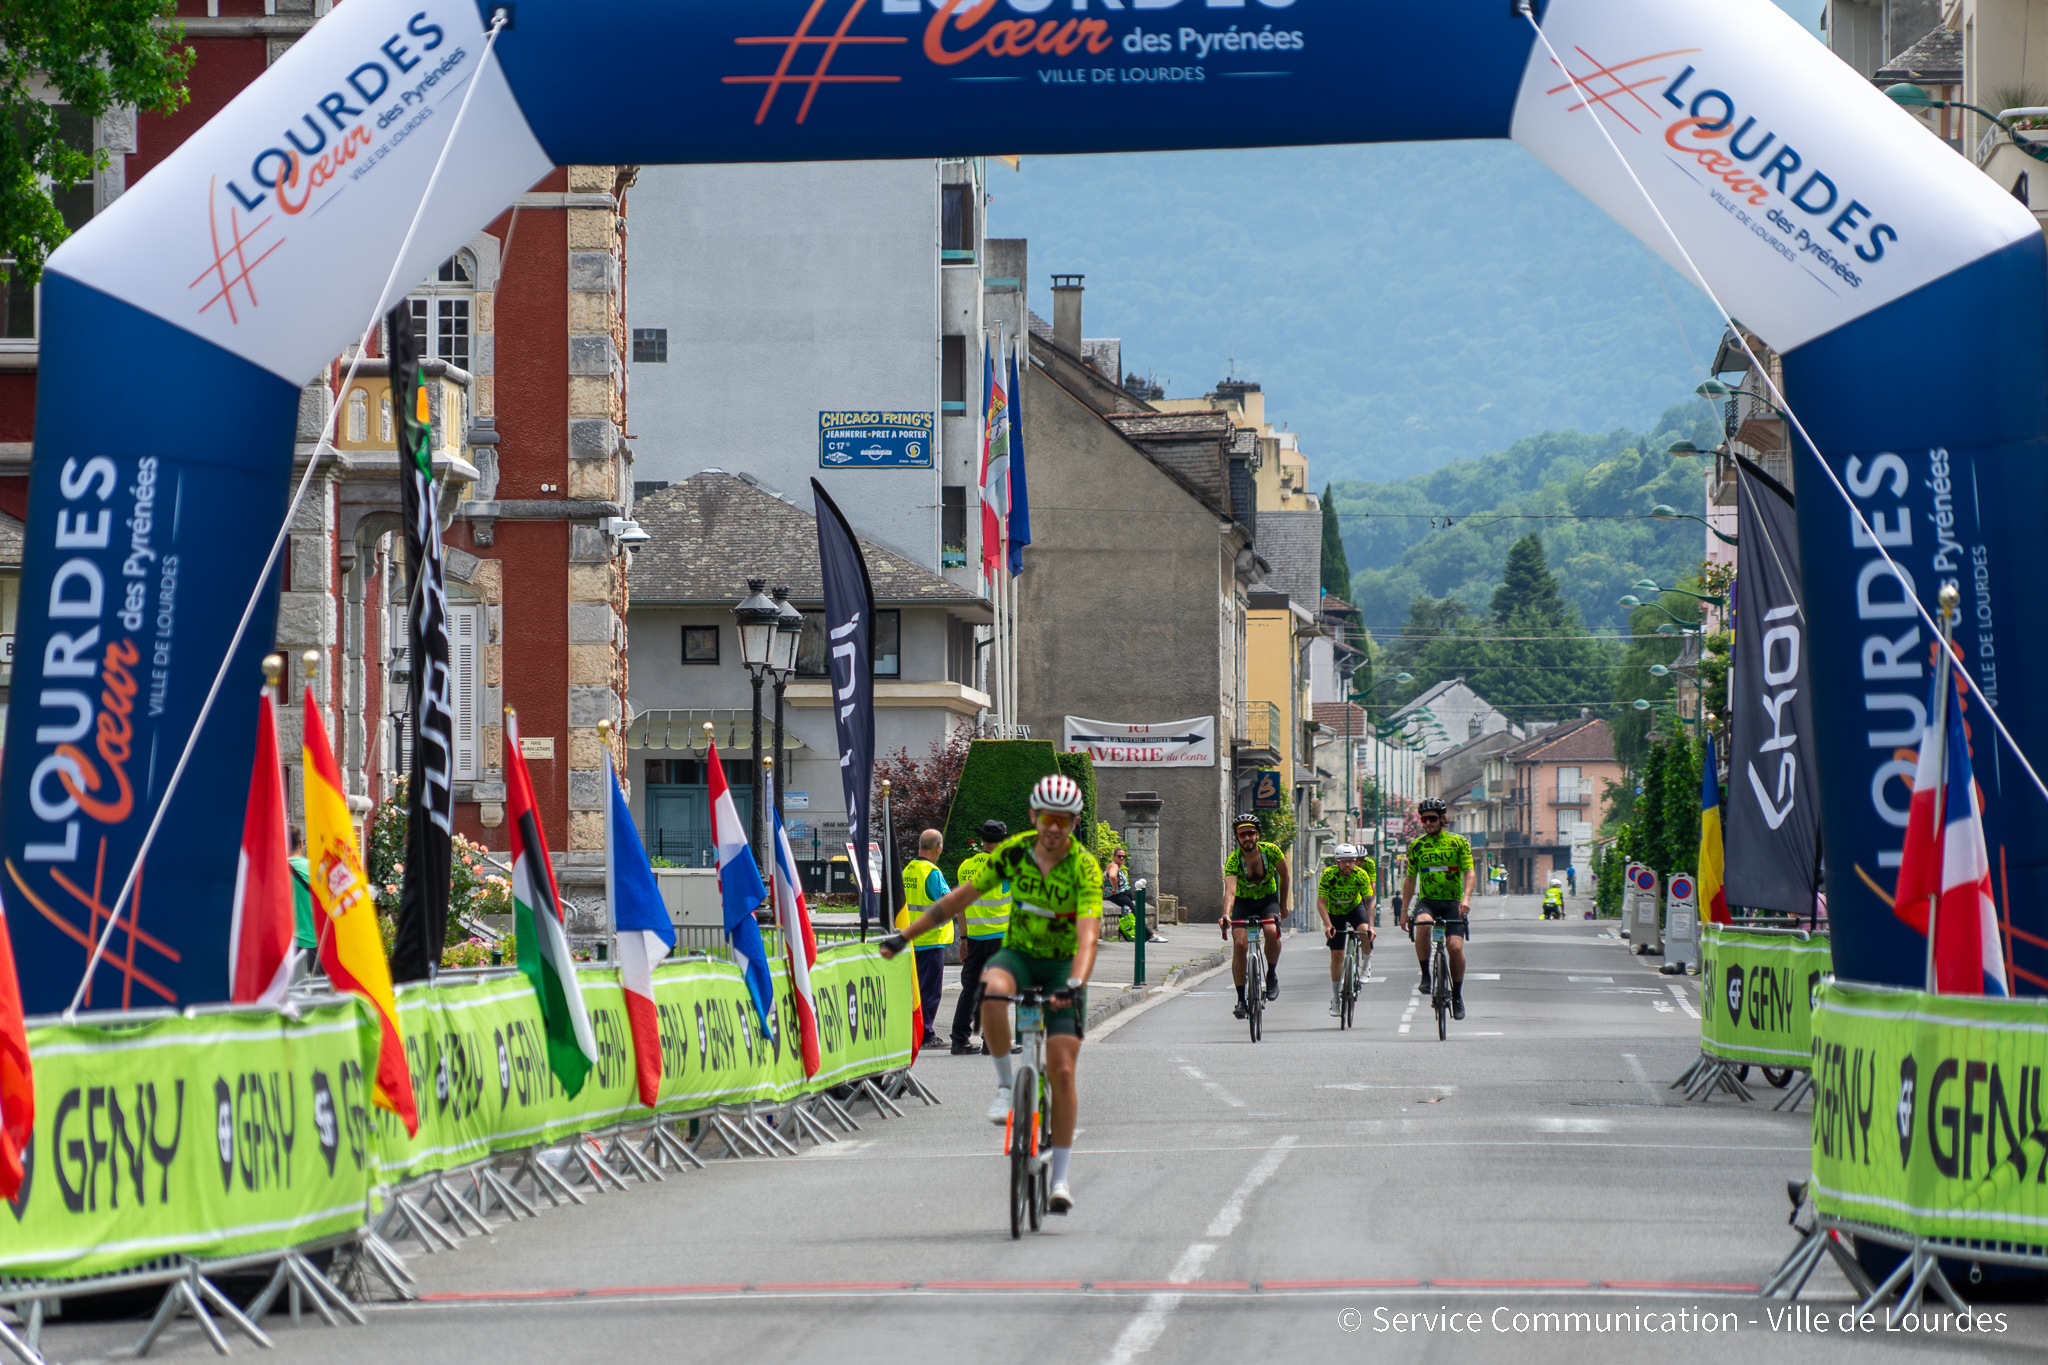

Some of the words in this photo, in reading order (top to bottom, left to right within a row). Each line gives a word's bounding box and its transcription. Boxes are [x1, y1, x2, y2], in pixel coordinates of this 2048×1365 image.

[1038, 68, 1086, 83] VILLE
[1091, 67, 1116, 82] DE
[1120, 66, 1205, 82] LOURDES
[1122, 27, 1172, 53] des
[1178, 24, 1304, 58] Pyrénées
[225, 10, 444, 213] LOURDES
[376, 102, 404, 130] des
[399, 46, 467, 106] Pyrénées
[349, 156, 377, 181] VILLE
[375, 143, 391, 160] DE
[389, 105, 433, 147] LOURDES
[1662, 65, 1898, 264] LOURDES
[1710, 187, 1737, 215] VILLE
[1735, 209, 1751, 226] DE
[1750, 222, 1798, 263] LOURDES
[1766, 207, 1796, 235] des
[1794, 228, 1863, 288] Pyrénées
[821, 412, 879, 427] CHICAGO
[882, 413, 932, 428] FRING'S
[825, 430, 867, 438] JEANNERIE
[871, 430, 889, 438] PRET
[899, 430, 927, 438] PORTER
[122, 455, 159, 577] Pyrénées
[1924, 446, 1964, 572] Pyrénées
[117, 580, 147, 631] des
[156, 553, 180, 638] LOURDES
[1971, 544, 1993, 628] LOURDES
[24, 454, 118, 862] LOURDES
[154, 639, 172, 666] DE
[1979, 632, 1995, 658] DE
[148, 669, 167, 717] VILLE
[1166, 752, 1178, 761] du
[1017, 875, 1069, 906] GFNY
[1420, 851, 1453, 863] GFNY
[706, 998, 736, 1071] GFNY
[818, 983, 844, 1054] GFNY
[860, 975, 886, 1041] GFNY
[1748, 965, 1794, 1034] GFNY
[237, 1071, 296, 1192] GFNY
[1821, 1042, 1875, 1165] GFNY
[53, 1078, 184, 1214] GFNY
